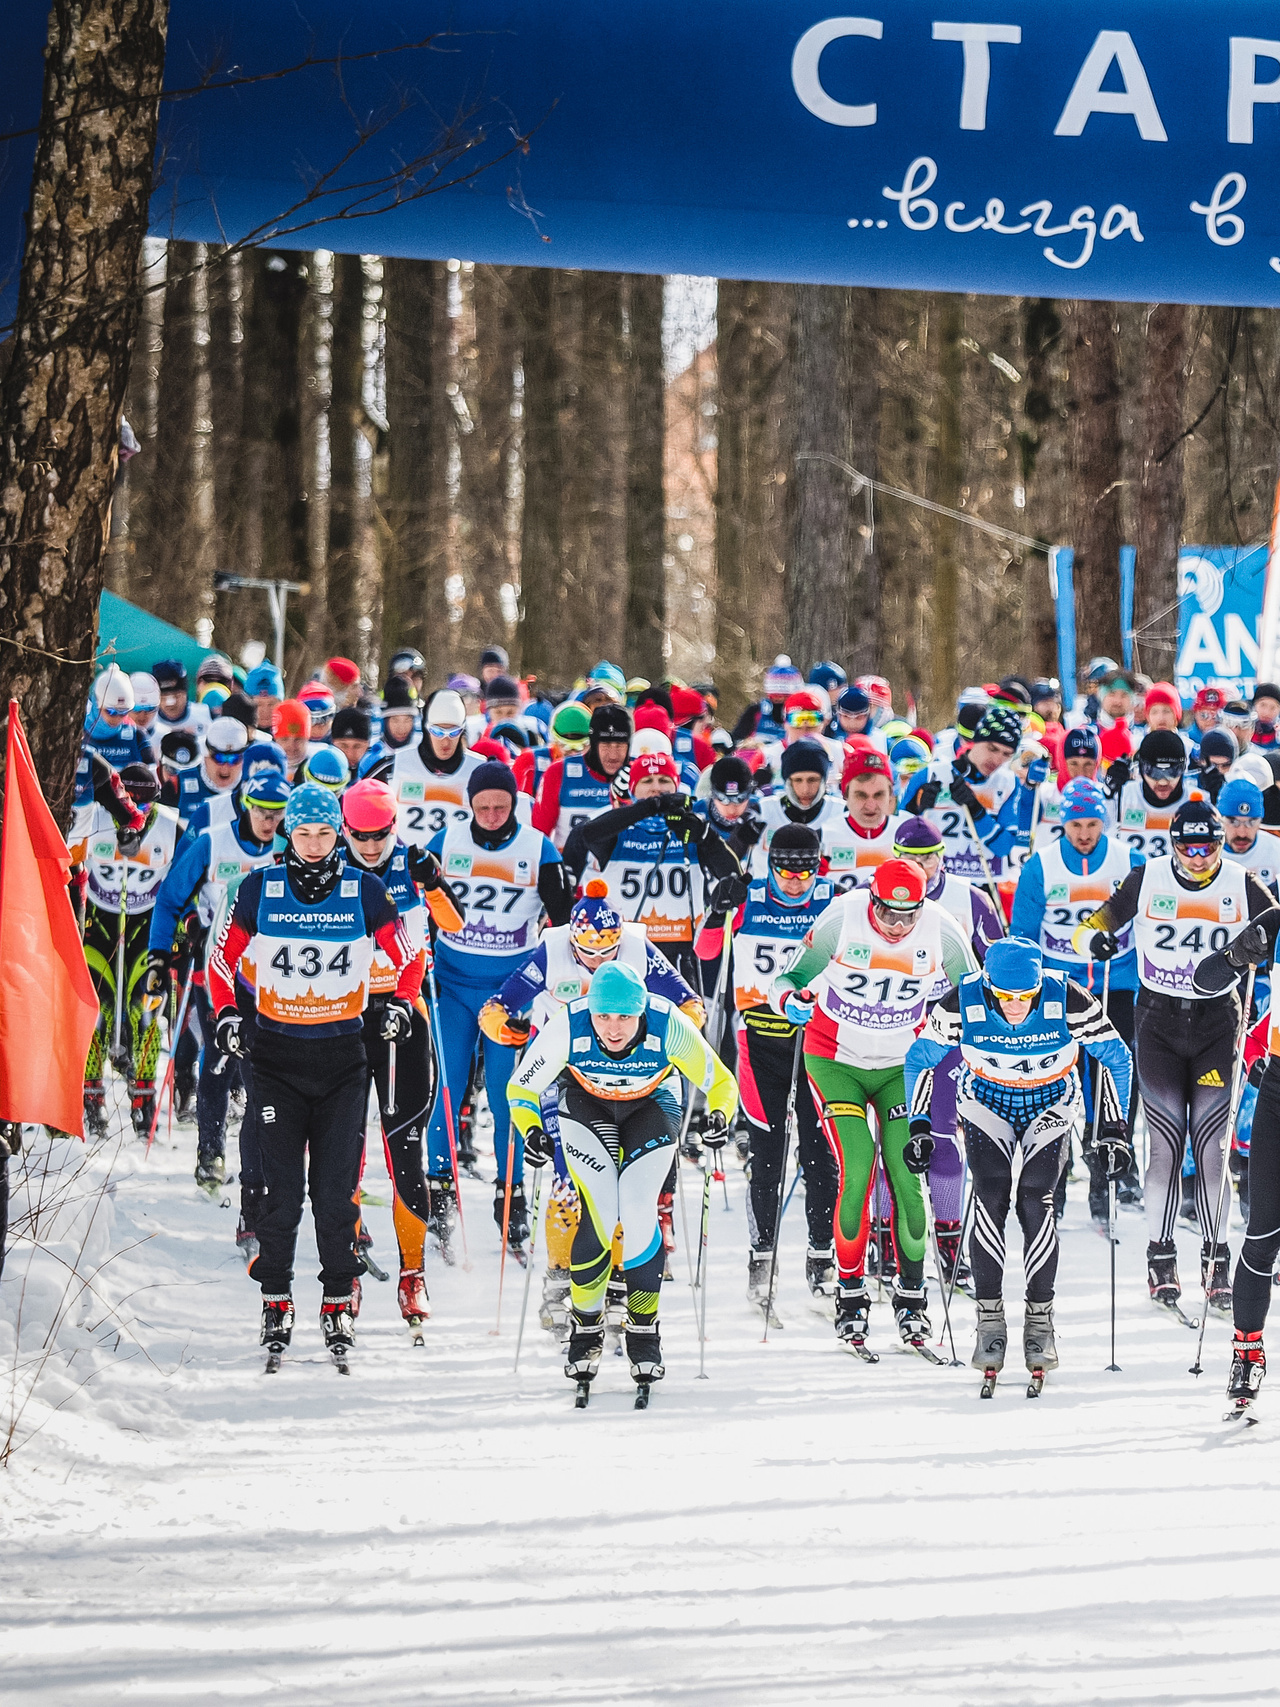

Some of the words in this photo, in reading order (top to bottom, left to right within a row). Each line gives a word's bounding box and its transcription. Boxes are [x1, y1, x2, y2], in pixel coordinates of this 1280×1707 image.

[1190, 172, 1247, 246] в
[620, 867, 688, 899] 500
[451, 881, 525, 914] 227
[278, 913, 355, 924] РОСАВТОБАНК
[761, 914, 819, 925] РОСАВТОБА
[1154, 924, 1230, 954] 240
[270, 943, 353, 979] 434
[843, 973, 922, 1003] 215
[1154, 969, 1193, 985] МАРА
[284, 1001, 331, 1013] МАРАФОН
[331, 1001, 349, 1011] МГУ
[840, 1003, 912, 1023] МАРАФОН
[984, 1031, 1061, 1045] РОСАВТОБАНК
[1033, 1118, 1070, 1136] adidas
[565, 1142, 606, 1173] sportful
